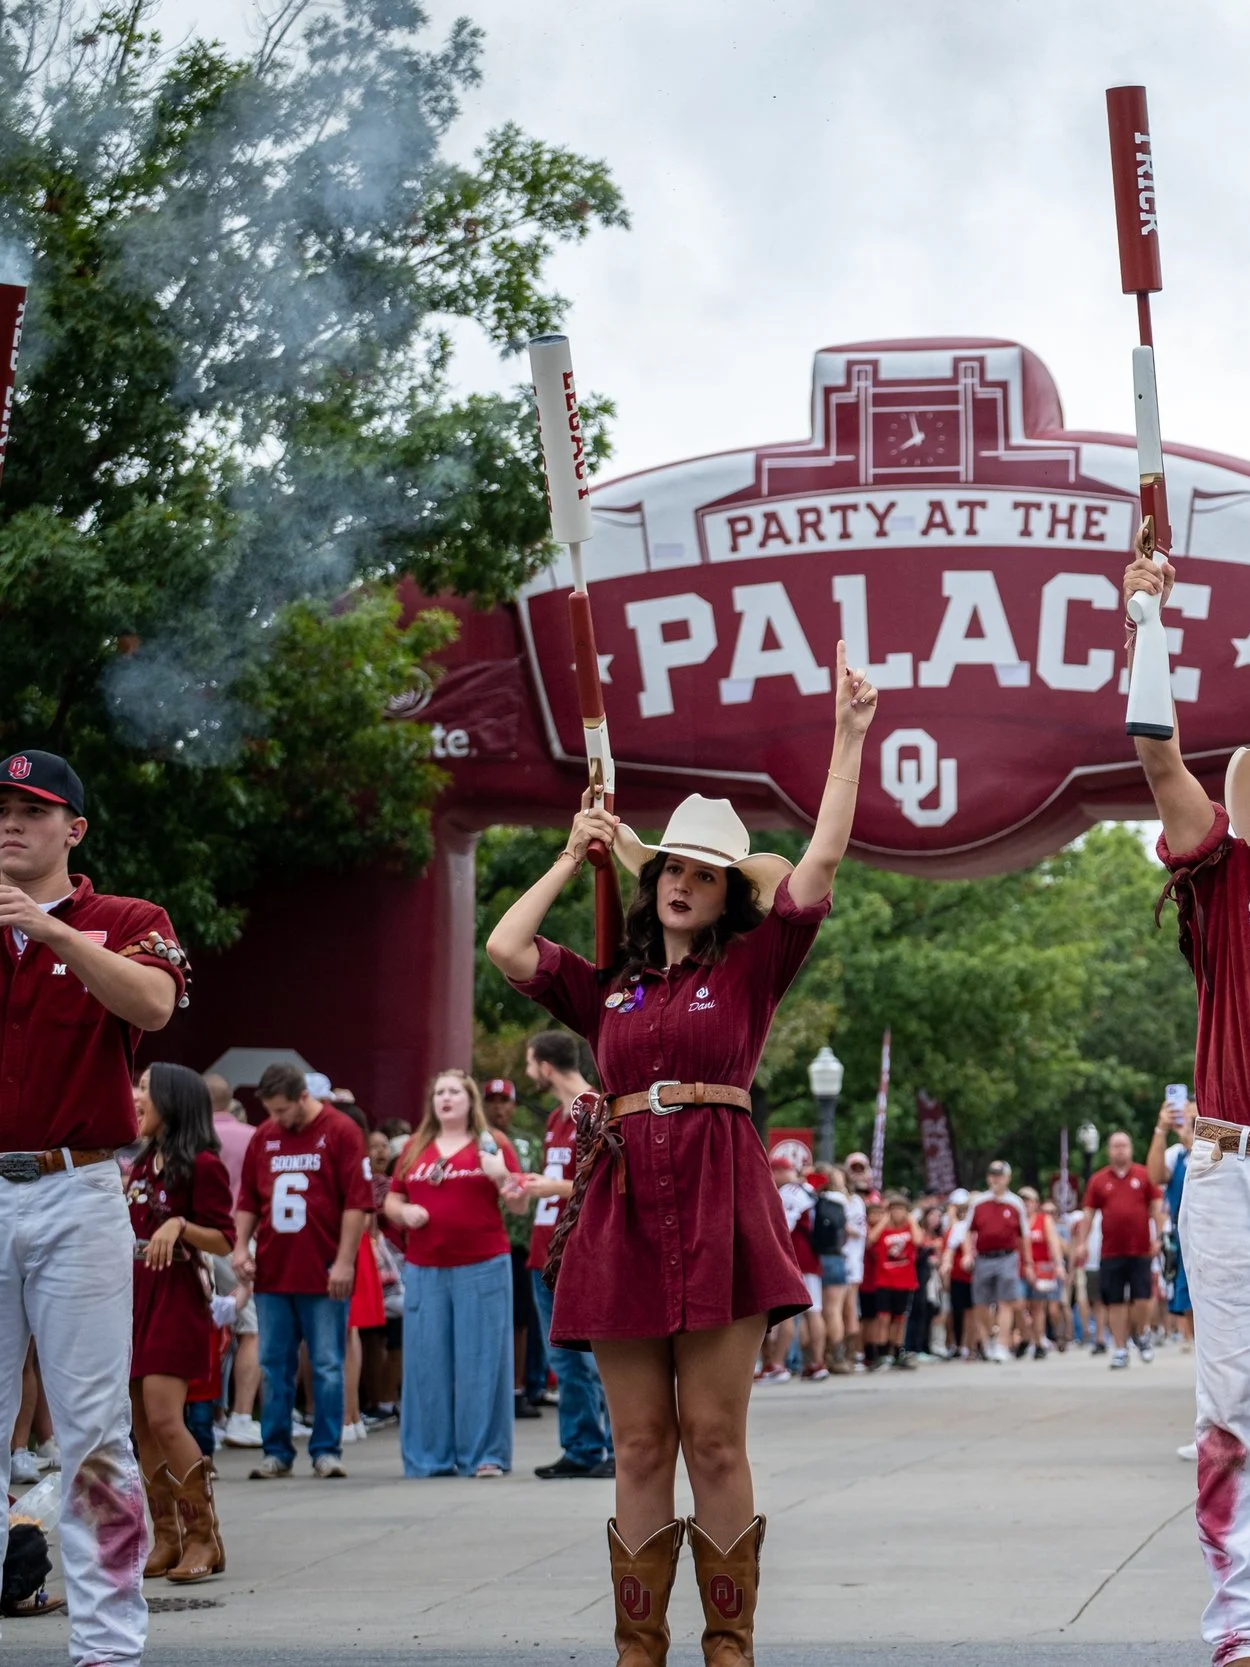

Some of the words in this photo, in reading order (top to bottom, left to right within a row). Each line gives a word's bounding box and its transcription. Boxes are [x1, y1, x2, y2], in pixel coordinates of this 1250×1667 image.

[727, 501, 897, 553] PARTY
[921, 500, 988, 537] AT
[1013, 501, 1108, 541] THE
[624, 570, 1211, 718] PALACE
[8, 756, 32, 779] OU
[881, 728, 958, 828] OU
[270, 1153, 321, 1173] SOONERS
[271, 1172, 309, 1233] 6
[619, 1574, 651, 1622] OU
[708, 1573, 743, 1620] OU
